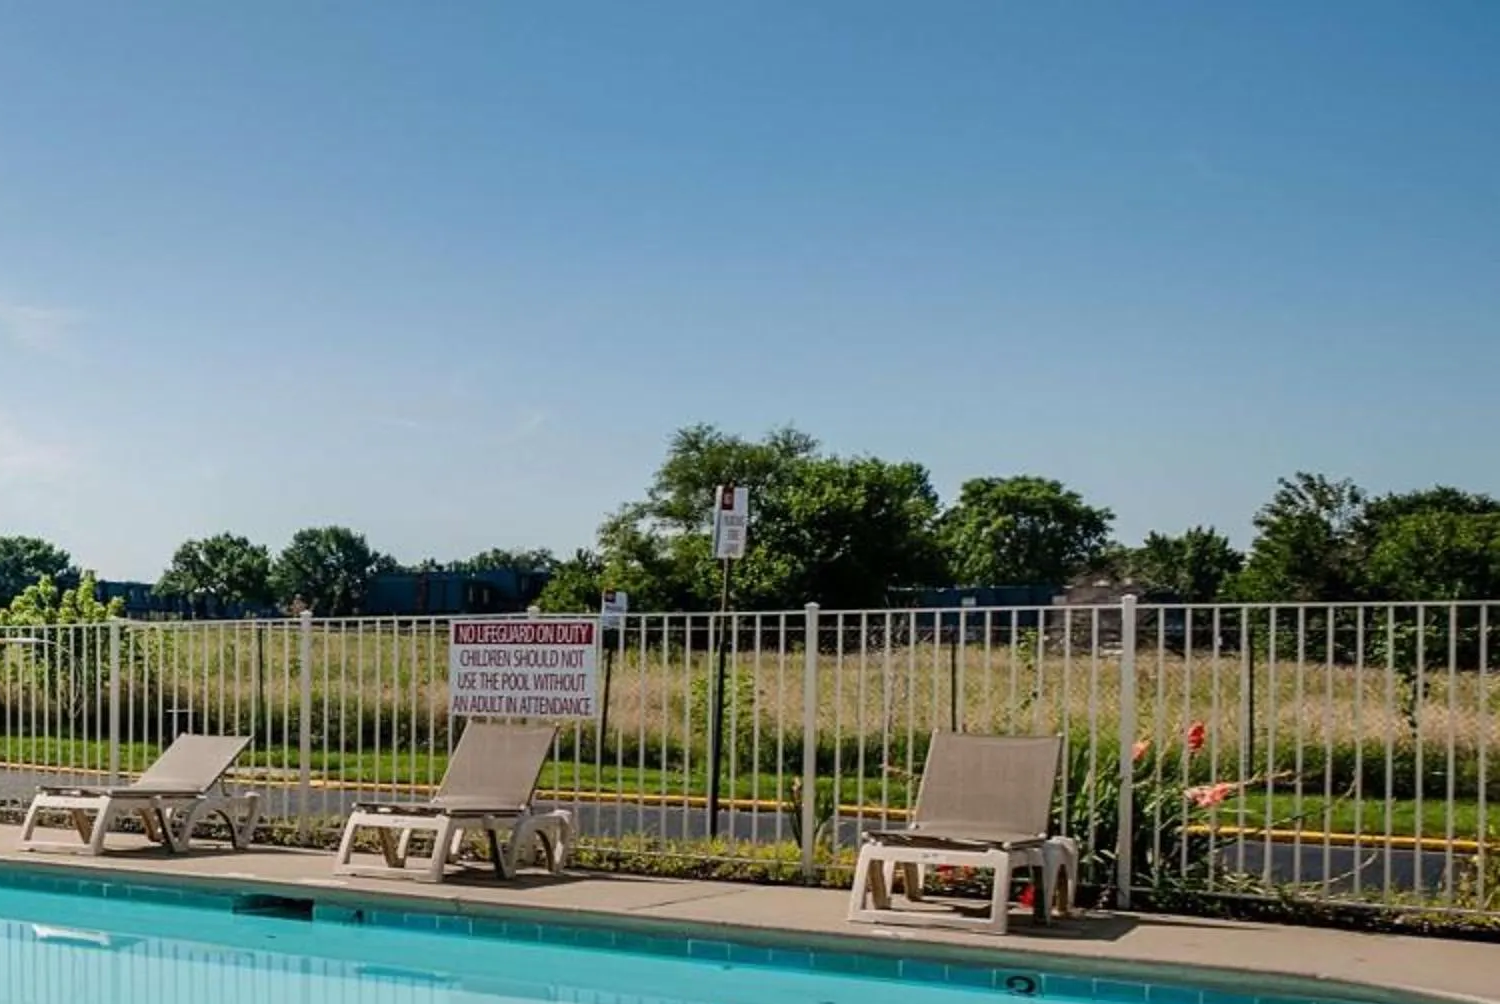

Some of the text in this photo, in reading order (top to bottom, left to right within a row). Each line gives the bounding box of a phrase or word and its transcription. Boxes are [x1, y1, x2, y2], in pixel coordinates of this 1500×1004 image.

[459, 625, 589, 642] NO LIFEGUARD ON DUTY
[460, 649, 584, 668] CHILDREN SHOULD NOT
[457, 672, 587, 692] USE THE POOL WITHOUT
[452, 695, 592, 716] AN ADULT IN ATTENDANCE
